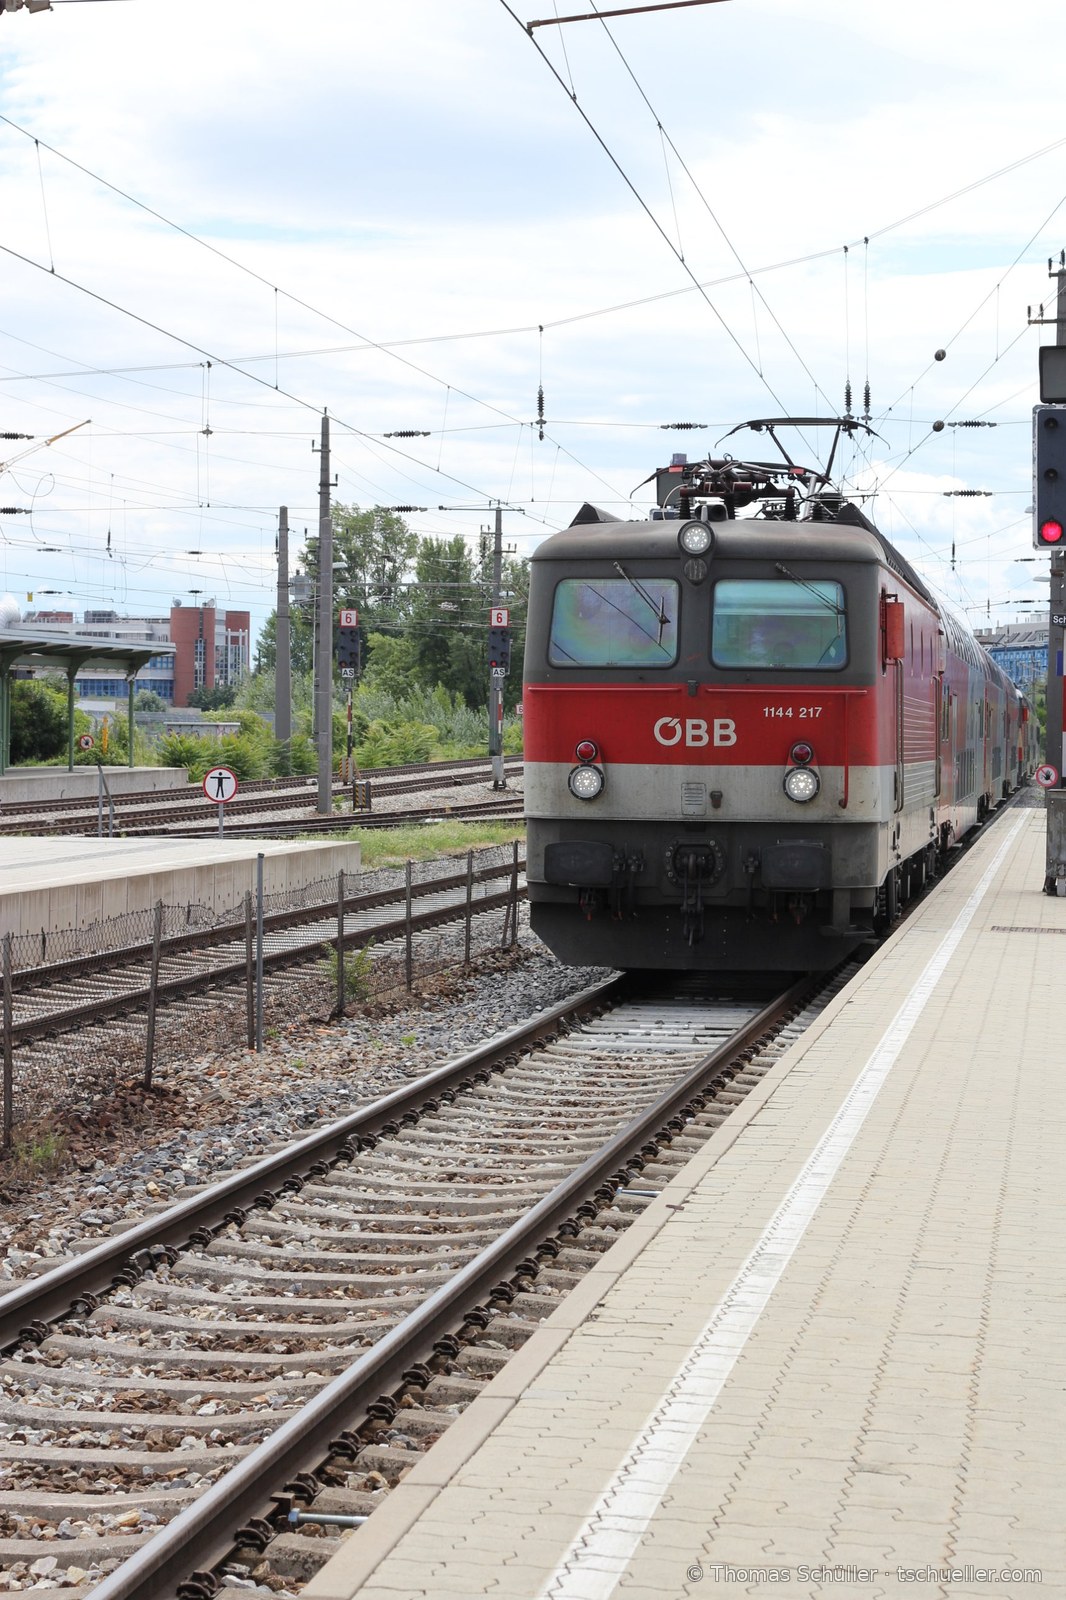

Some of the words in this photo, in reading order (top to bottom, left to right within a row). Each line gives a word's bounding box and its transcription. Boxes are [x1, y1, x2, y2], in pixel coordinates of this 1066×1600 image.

[345, 612, 352, 624] 6
[496, 612, 503, 624] 6
[342, 669, 354, 677] AS
[493, 668, 505, 676] AS
[763, 706, 793, 718] 1144
[799, 706, 823, 718] 217
[653, 716, 738, 747] ÖBB
